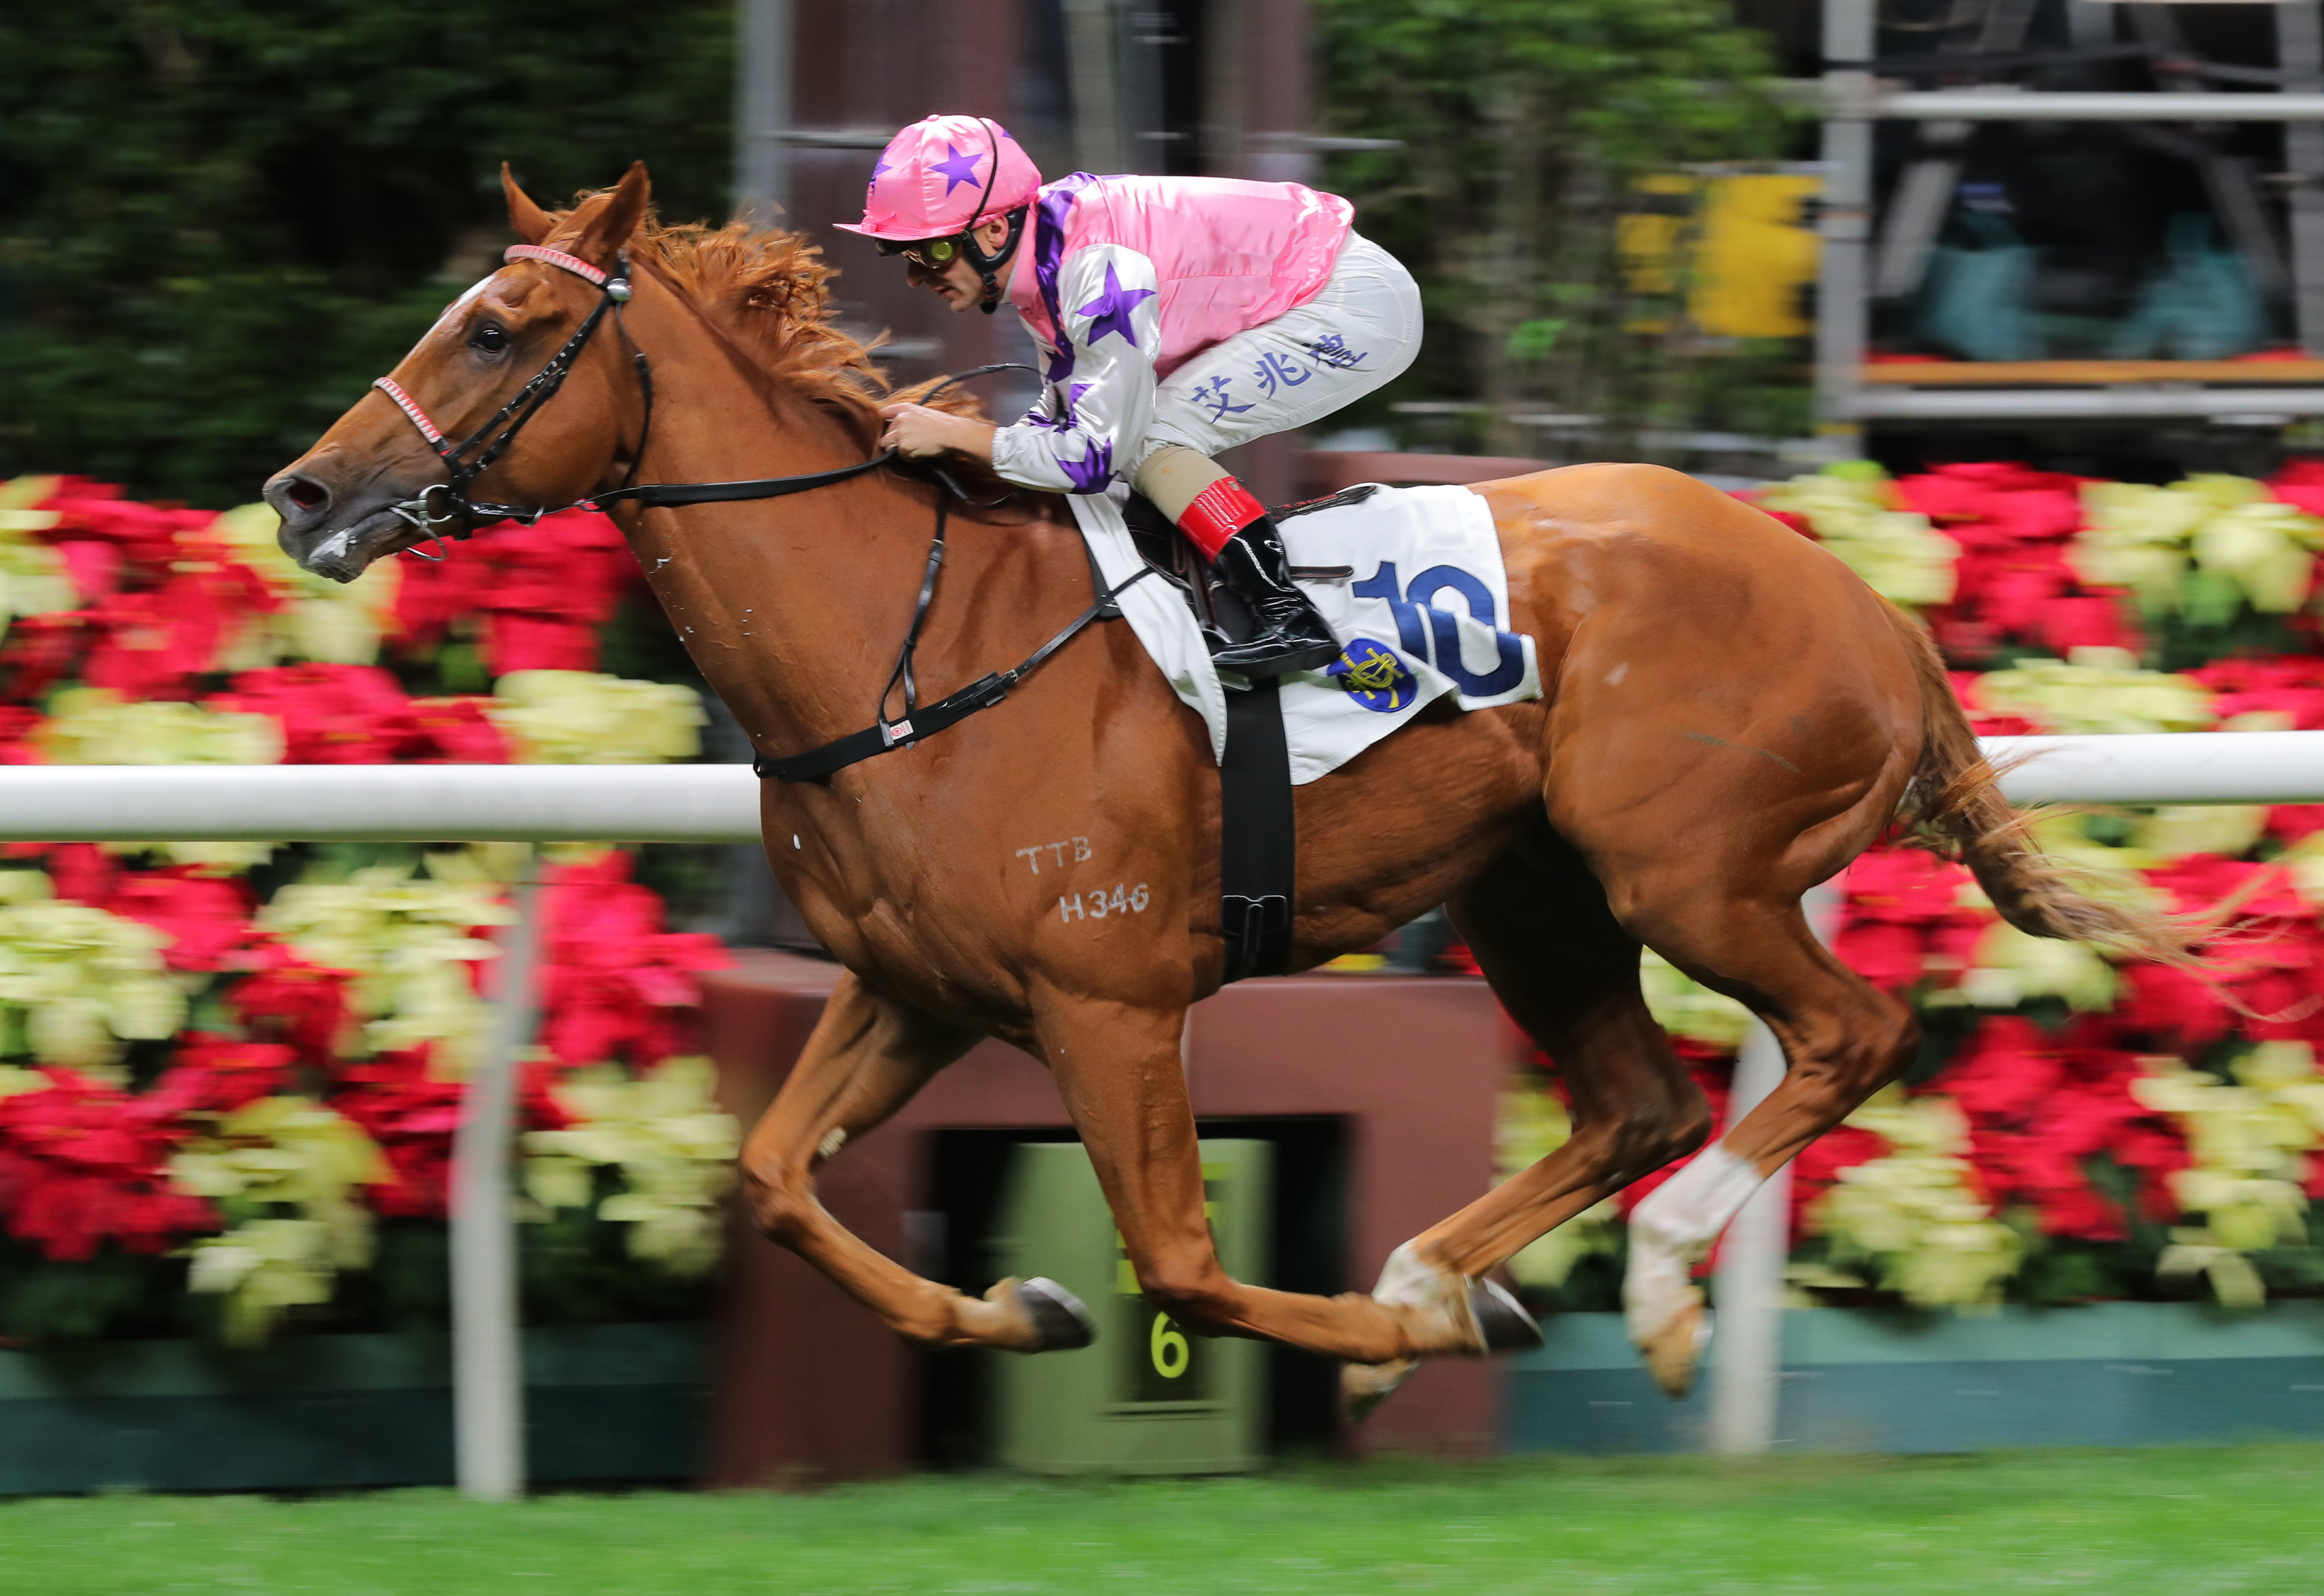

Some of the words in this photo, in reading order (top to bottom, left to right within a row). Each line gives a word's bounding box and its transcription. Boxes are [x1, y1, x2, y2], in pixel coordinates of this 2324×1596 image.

[1352, 561, 1525, 697] 10
[1016, 836, 1092, 874] TTB
[1059, 883, 1149, 923] H346
[1151, 1311, 1189, 1378] 6
